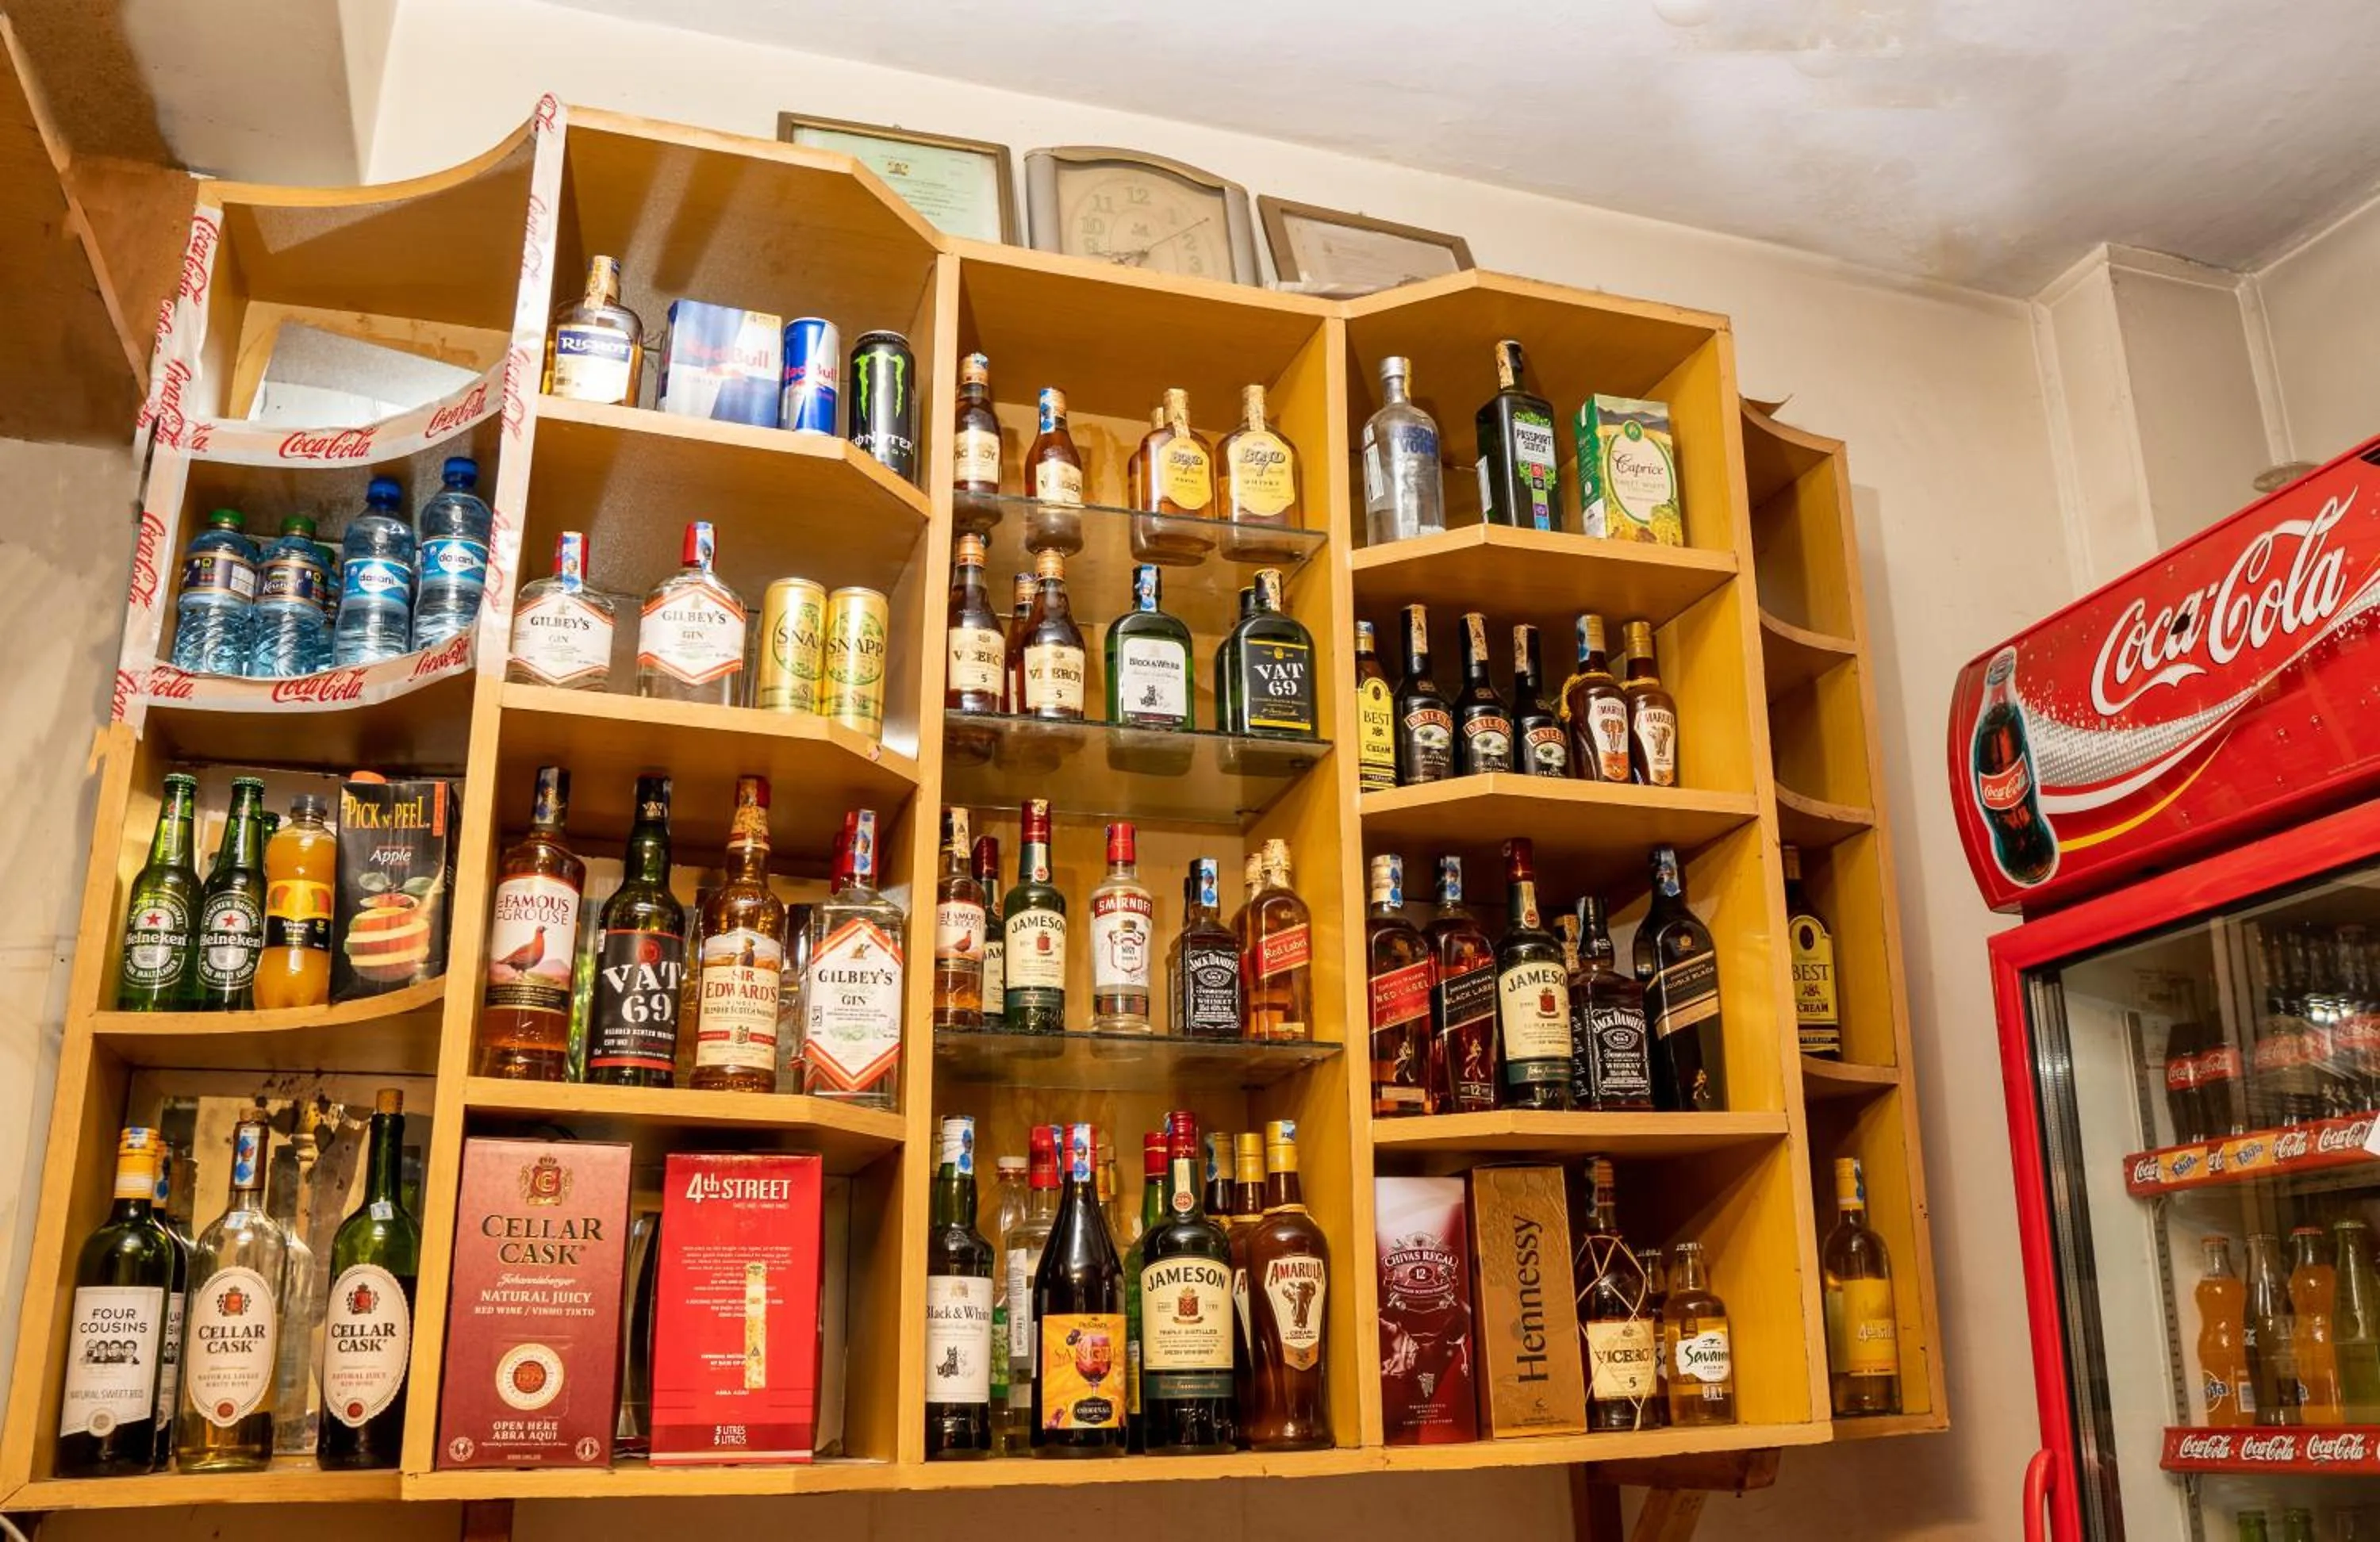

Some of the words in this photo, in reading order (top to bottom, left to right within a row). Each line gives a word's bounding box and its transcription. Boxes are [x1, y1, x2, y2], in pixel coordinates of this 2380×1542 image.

[1092, 194, 1115, 213] 11
[1125, 186, 1150, 204] 12
[278, 429, 379, 459] Coca-Cola
[1516, 428, 1552, 446] PASSPORT
[1612, 451, 1664, 476] Caprice
[2091, 484, 2359, 717] Coca-Cola
[531, 616, 590, 631] GILBEY'S
[662, 610, 727, 625] GILBEY'S
[777, 627, 823, 649] SNA
[827, 637, 883, 658] SNAPP
[1253, 662, 1305, 681] VAT
[272, 669, 369, 704] Coca-Cola
[1364, 711, 1390, 726] BEST
[347, 796, 381, 828] PICK
[369, 849, 412, 866] Apple
[505, 893, 570, 914] FAMOUS
[502, 906, 569, 926] GROUSE
[603, 959, 682, 995] VAT
[731, 969, 754, 982] SIR
[818, 968, 894, 986] GILBEY'S
[1792, 964, 1829, 981] BEST
[704, 980, 777, 1004] EDWARD'S
[841, 995, 867, 1006] GIN
[1469, 1084, 1481, 1095] 12
[2318, 1119, 2374, 1152] Coca-Col
[722, 1179, 793, 1201] STREET
[481, 1214, 604, 1241] CELLAR
[498, 1243, 579, 1266] CASK
[1386, 1251, 1421, 1266] CHIVAS
[1422, 1251, 1455, 1267] REGAL
[1147, 1266, 1226, 1293] JAMESON
[1269, 1261, 1324, 1287] AMARULA
[1415, 1268, 1426, 1279] 12
[481, 1290, 548, 1302] NATURAL
[551, 1291, 593, 1305] JUICY
[1514, 1214, 1549, 1384] Hennessy
[92, 1308, 137, 1320] FOUR
[79, 1321, 148, 1334] COUSINS
[198, 1323, 267, 1340] CELLAR
[331, 1322, 397, 1338] CELLAR
[205, 1340, 254, 1354] CASK
[337, 1338, 383, 1353] CASK
[1595, 1347, 1650, 1364] VICERO
[1684, 1345, 1727, 1368] Savan
[1629, 1376, 1637, 1388] 5
[493, 1421, 525, 1431] OPEN
[528, 1421, 559, 1431] HERE
[493, 1431, 524, 1440] ABRA
[529, 1431, 557, 1441] AQUI
[2179, 1433, 2232, 1460] Coca-Cola
[2240, 1434, 2297, 1462] Coca-Cola
[2305, 1433, 2366, 1462] Coca-Cola
